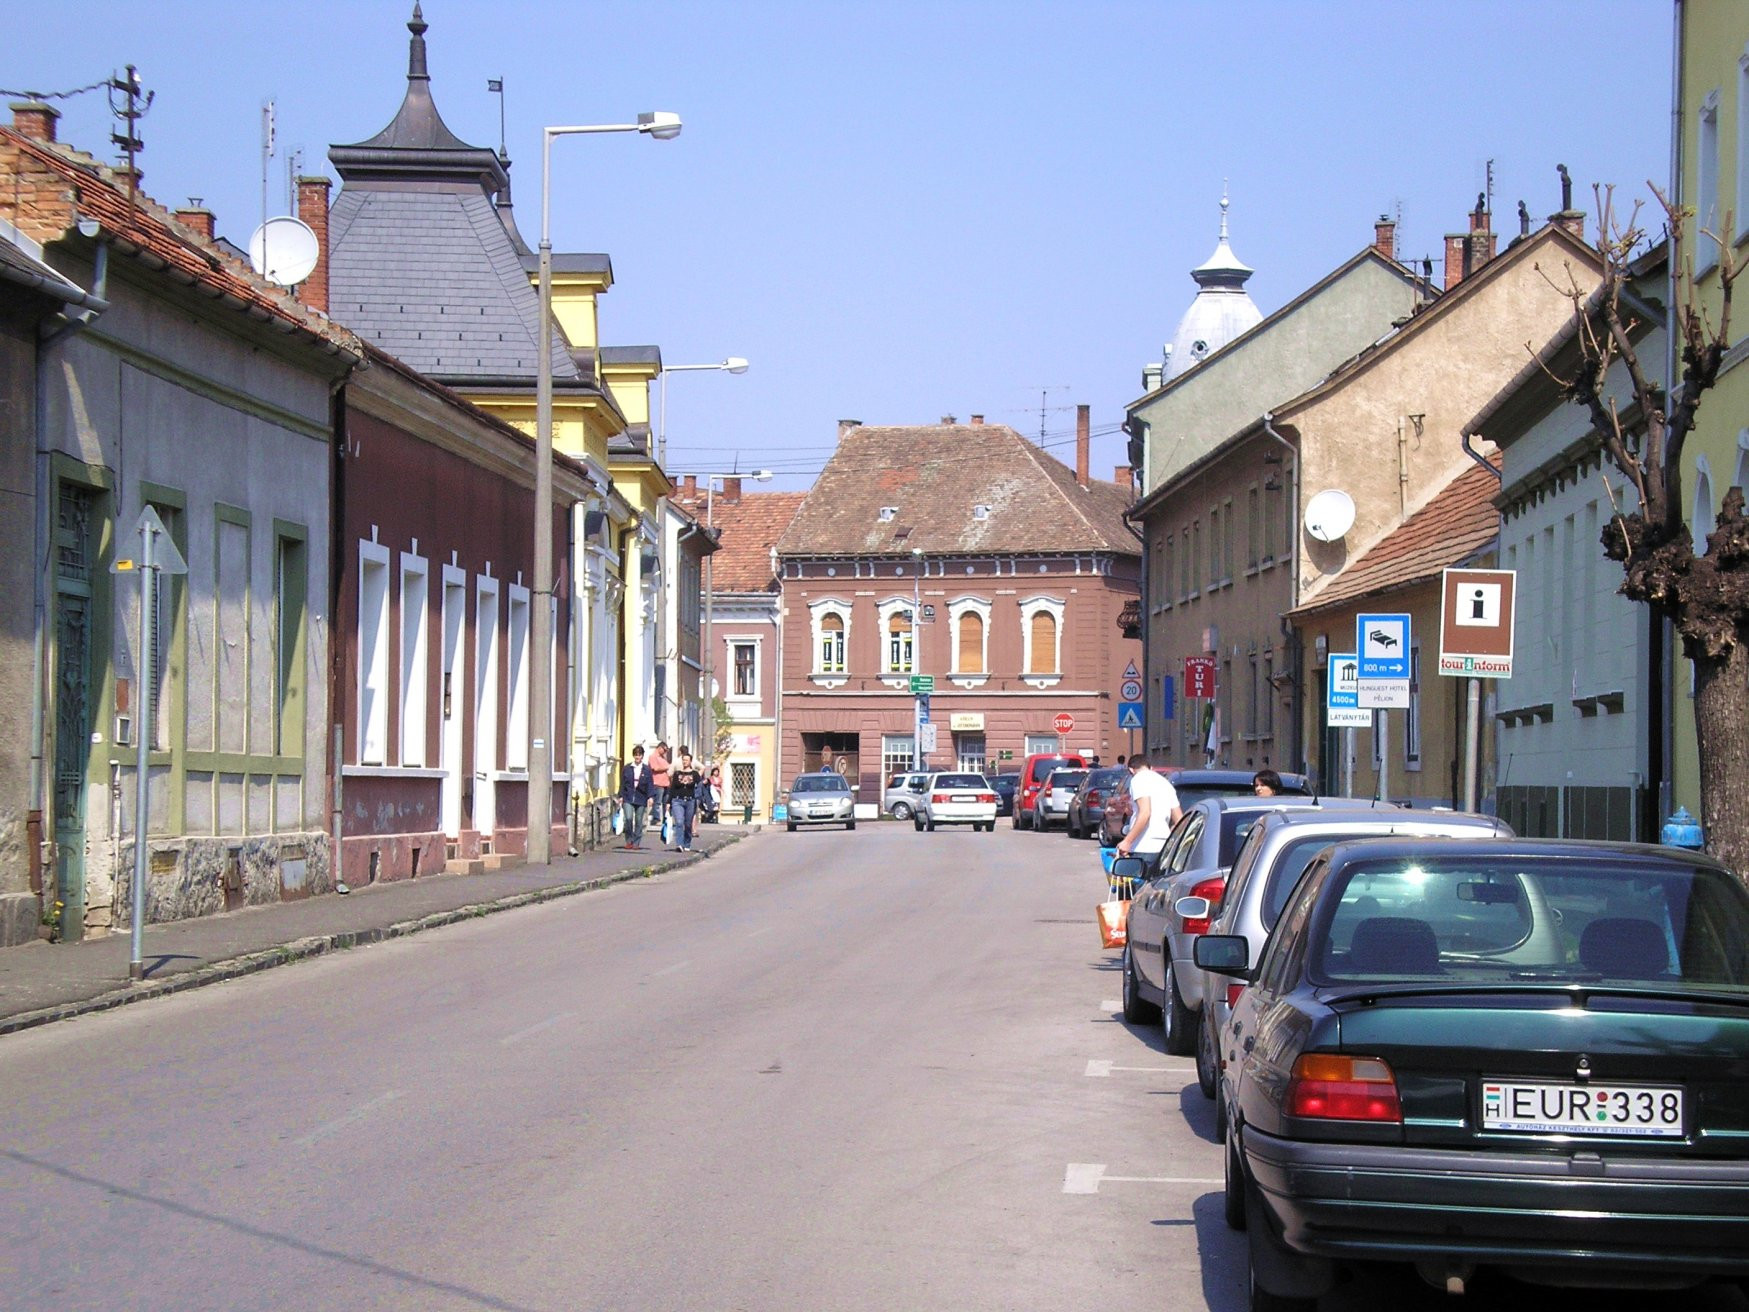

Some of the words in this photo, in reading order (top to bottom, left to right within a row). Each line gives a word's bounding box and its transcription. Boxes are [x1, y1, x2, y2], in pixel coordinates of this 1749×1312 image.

[1441, 657, 1510, 672] tourinform
[1195, 665, 1204, 697] TURI
[1126, 686, 1137, 695] 20
[1054, 719, 1073, 728] STOP
[1486, 1103, 1500, 1118] H
